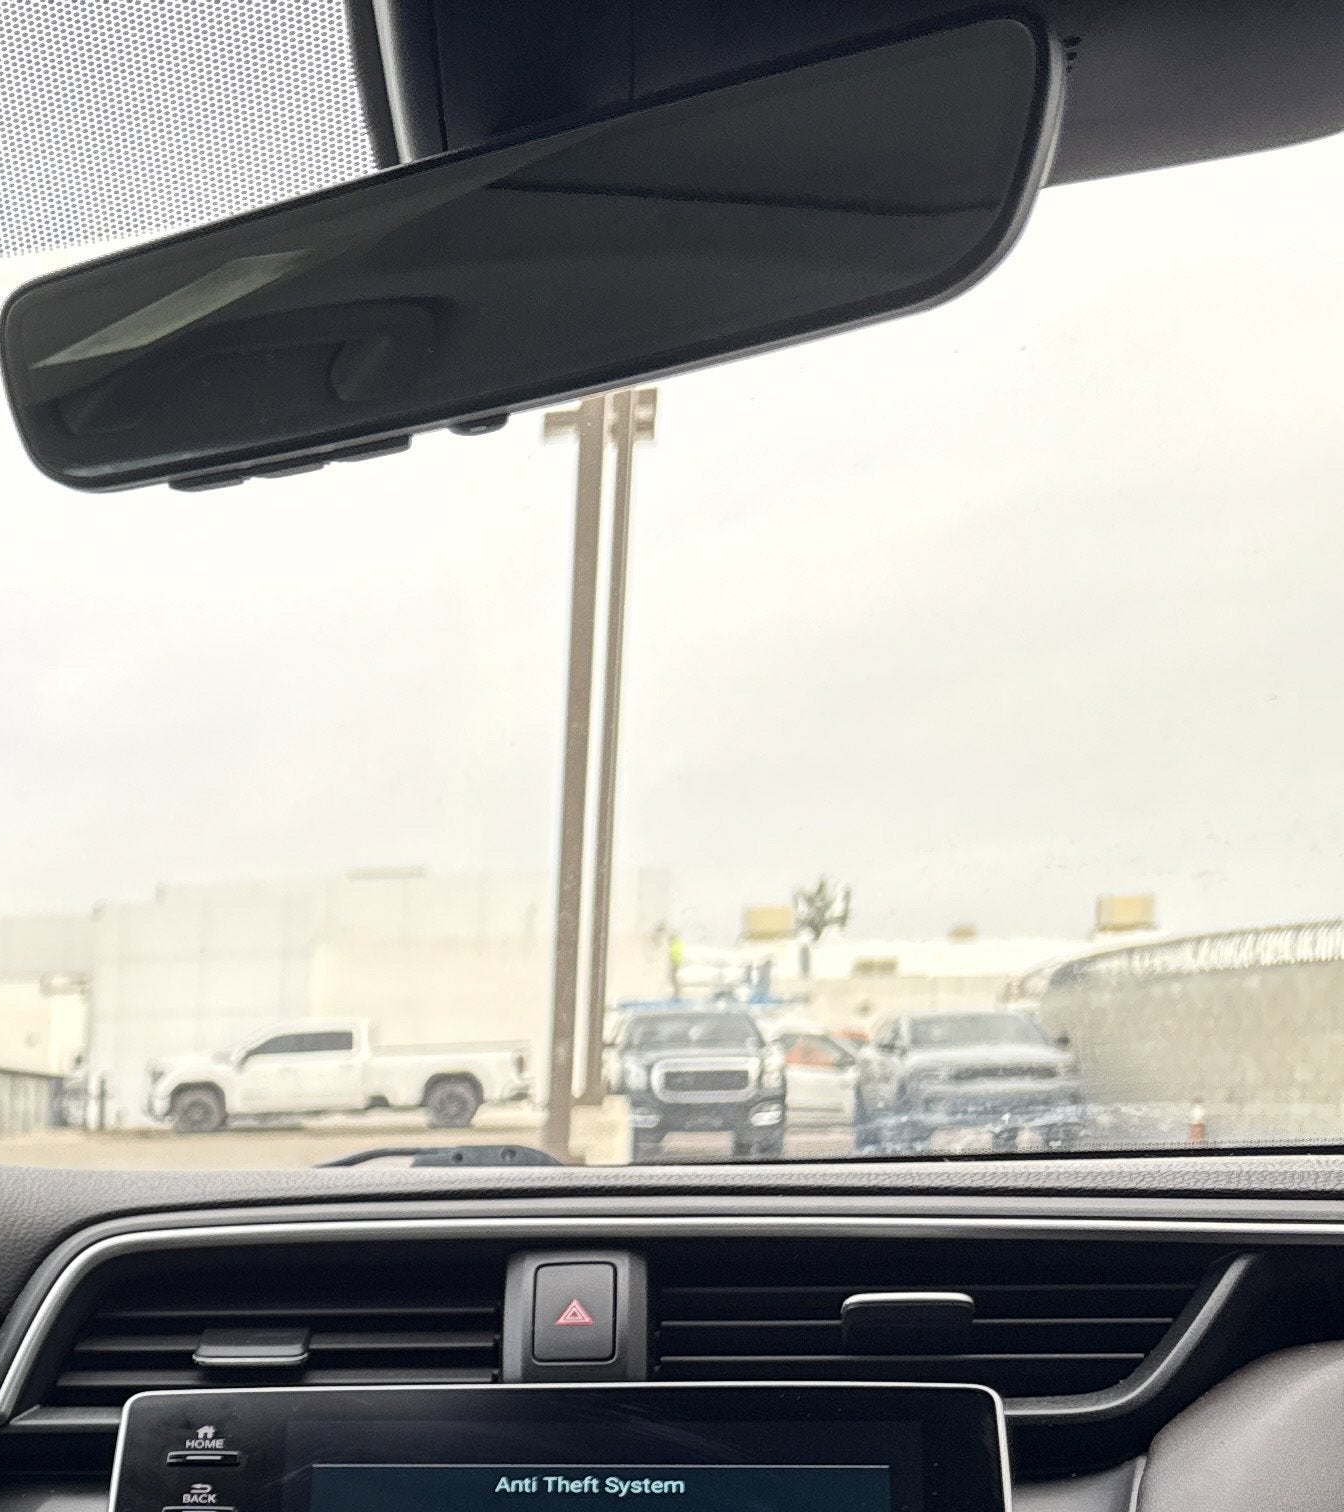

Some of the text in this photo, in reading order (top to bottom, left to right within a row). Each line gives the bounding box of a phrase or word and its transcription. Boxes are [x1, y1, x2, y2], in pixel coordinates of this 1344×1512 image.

[185, 1438, 225, 1449] HOME
[494, 1476, 686, 1498] Anti Theft System
[182, 1494, 217, 1504] BACK
